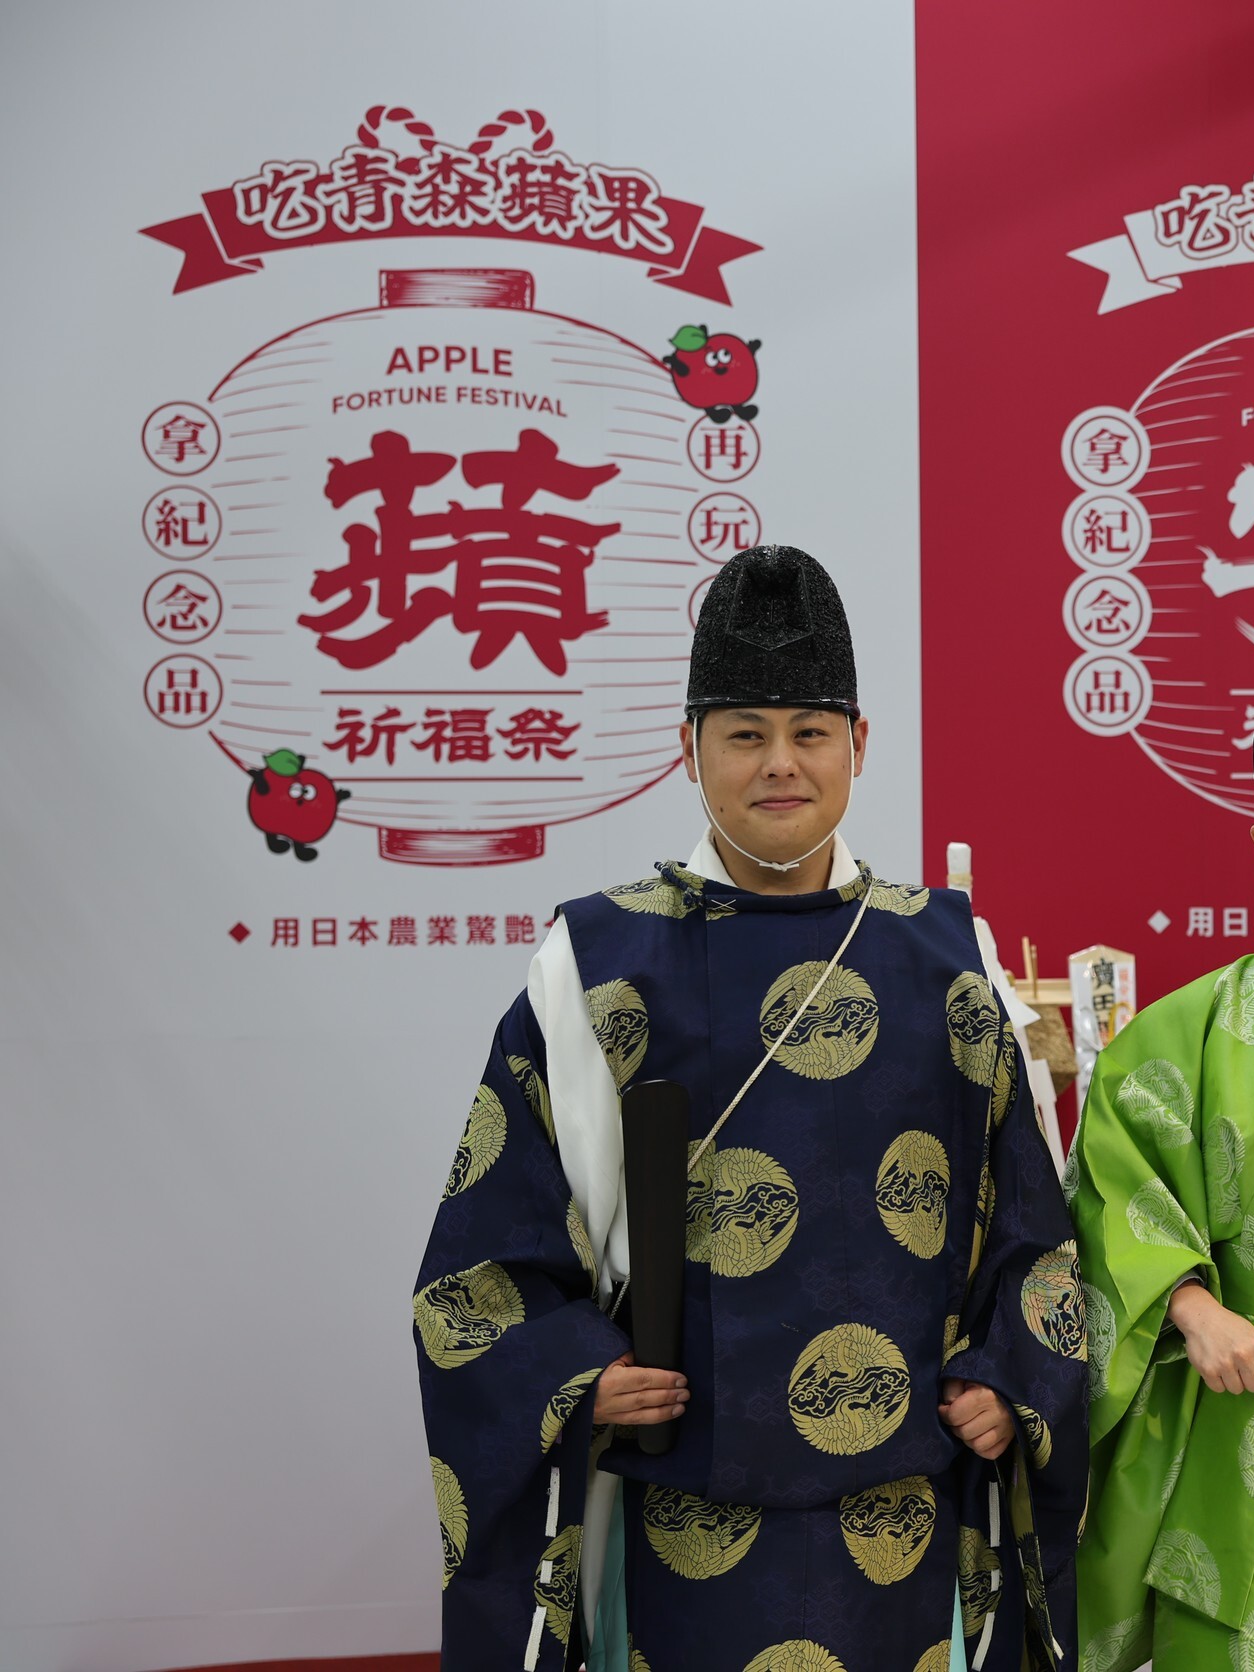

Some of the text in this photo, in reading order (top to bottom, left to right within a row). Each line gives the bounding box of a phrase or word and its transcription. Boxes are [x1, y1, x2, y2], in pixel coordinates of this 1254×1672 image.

[234, 146, 674, 252] 吃青森蘋果
[387, 346, 513, 377] APPLE
[332, 386, 568, 417] FORTUNE FESTIVAL
[154, 414, 210, 716] 拿紀念品
[1080, 428, 1132, 715] 拿紀念品
[323, 705, 582, 766] 祈福祭
[271, 914, 557, 948] 用日本農業驚艷
